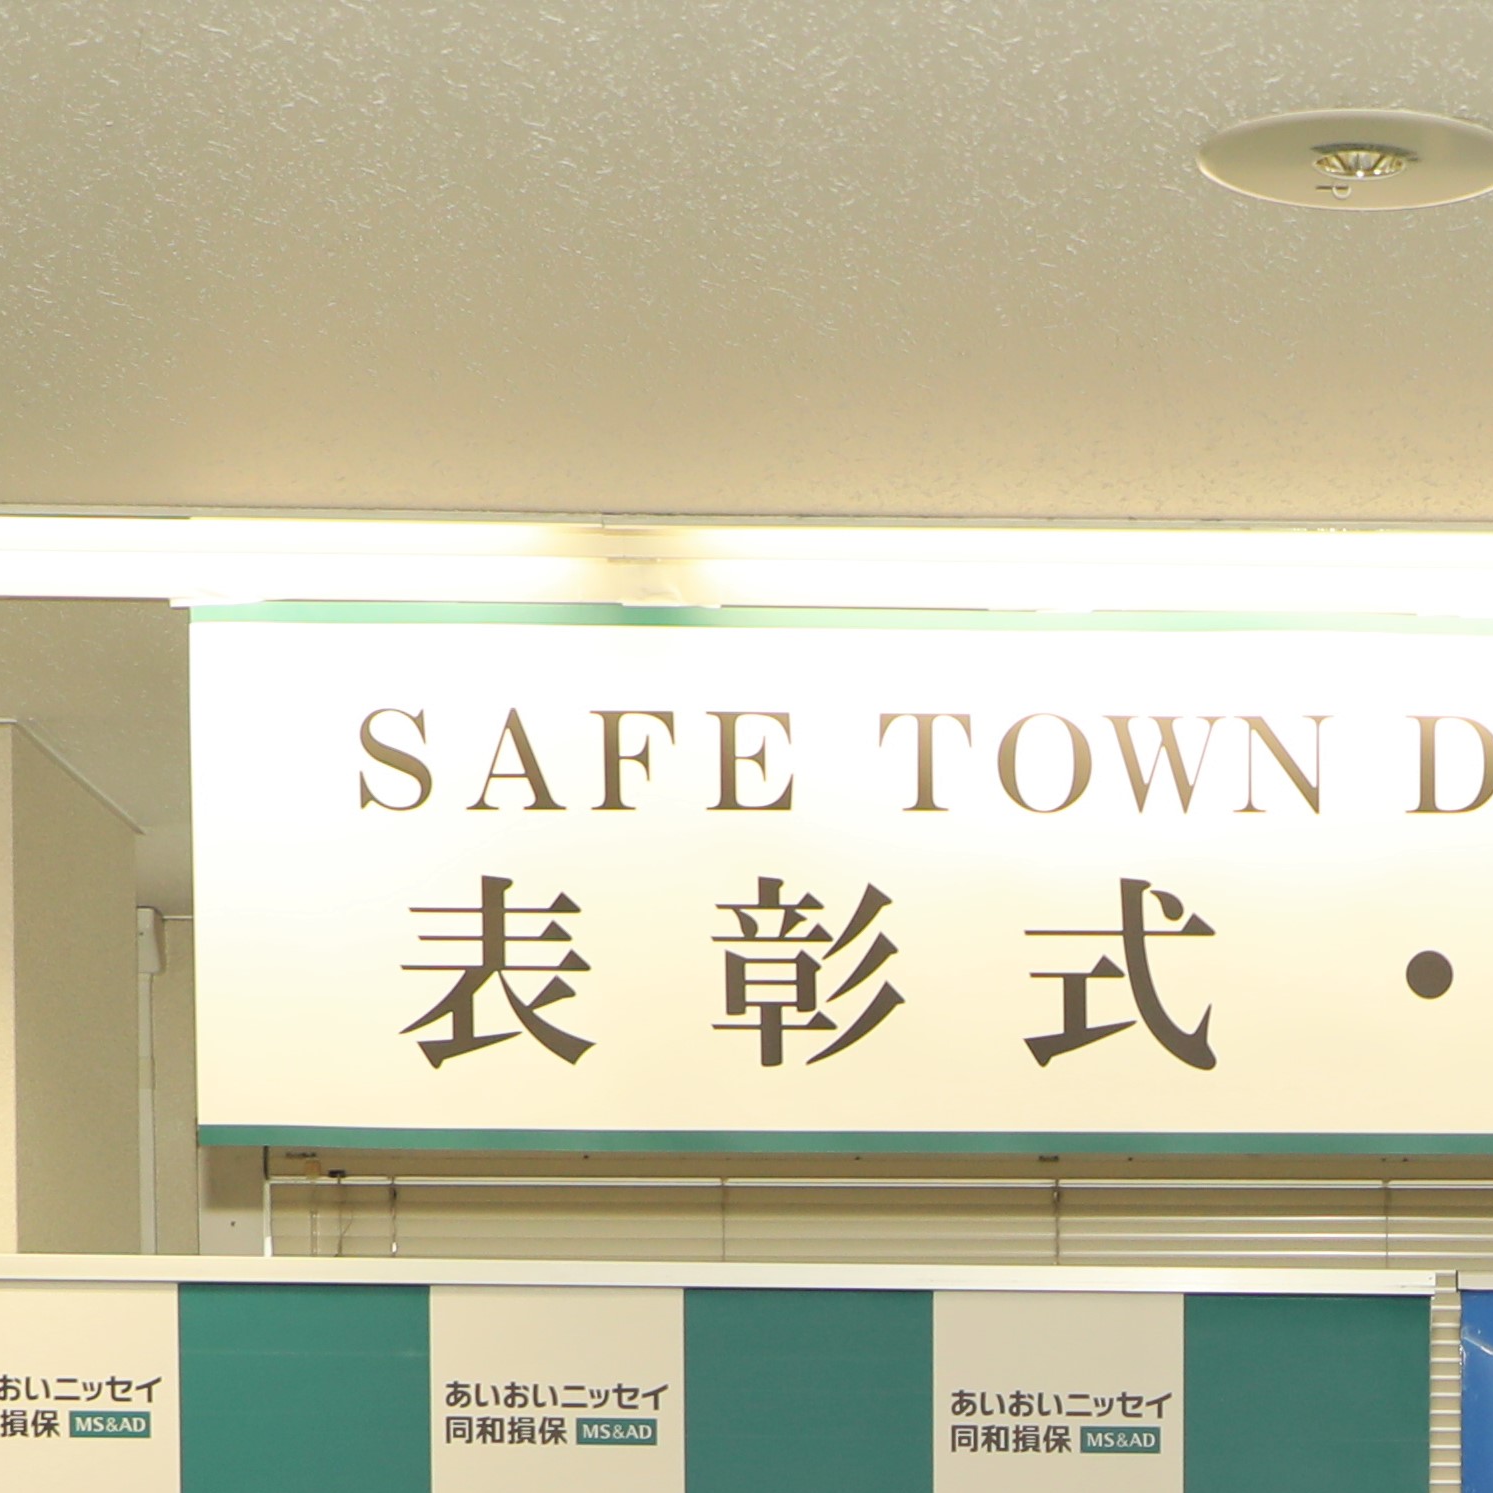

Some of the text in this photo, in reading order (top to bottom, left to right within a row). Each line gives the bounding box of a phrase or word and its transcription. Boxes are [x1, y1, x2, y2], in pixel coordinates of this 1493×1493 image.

[359, 707, 794, 812] SAFE
[879, 714, 1328, 815] TOWN
[445, 1380, 670, 1411] あいおいニッセイ
[950, 1389, 1173, 1419] あいおいニッセイ
[74, 1414, 148, 1434] MS&AD
[445, 1415, 654, 1445] 同和損保 MS&AD
[950, 1424, 1157, 1454] 同和損保 MS&AD
